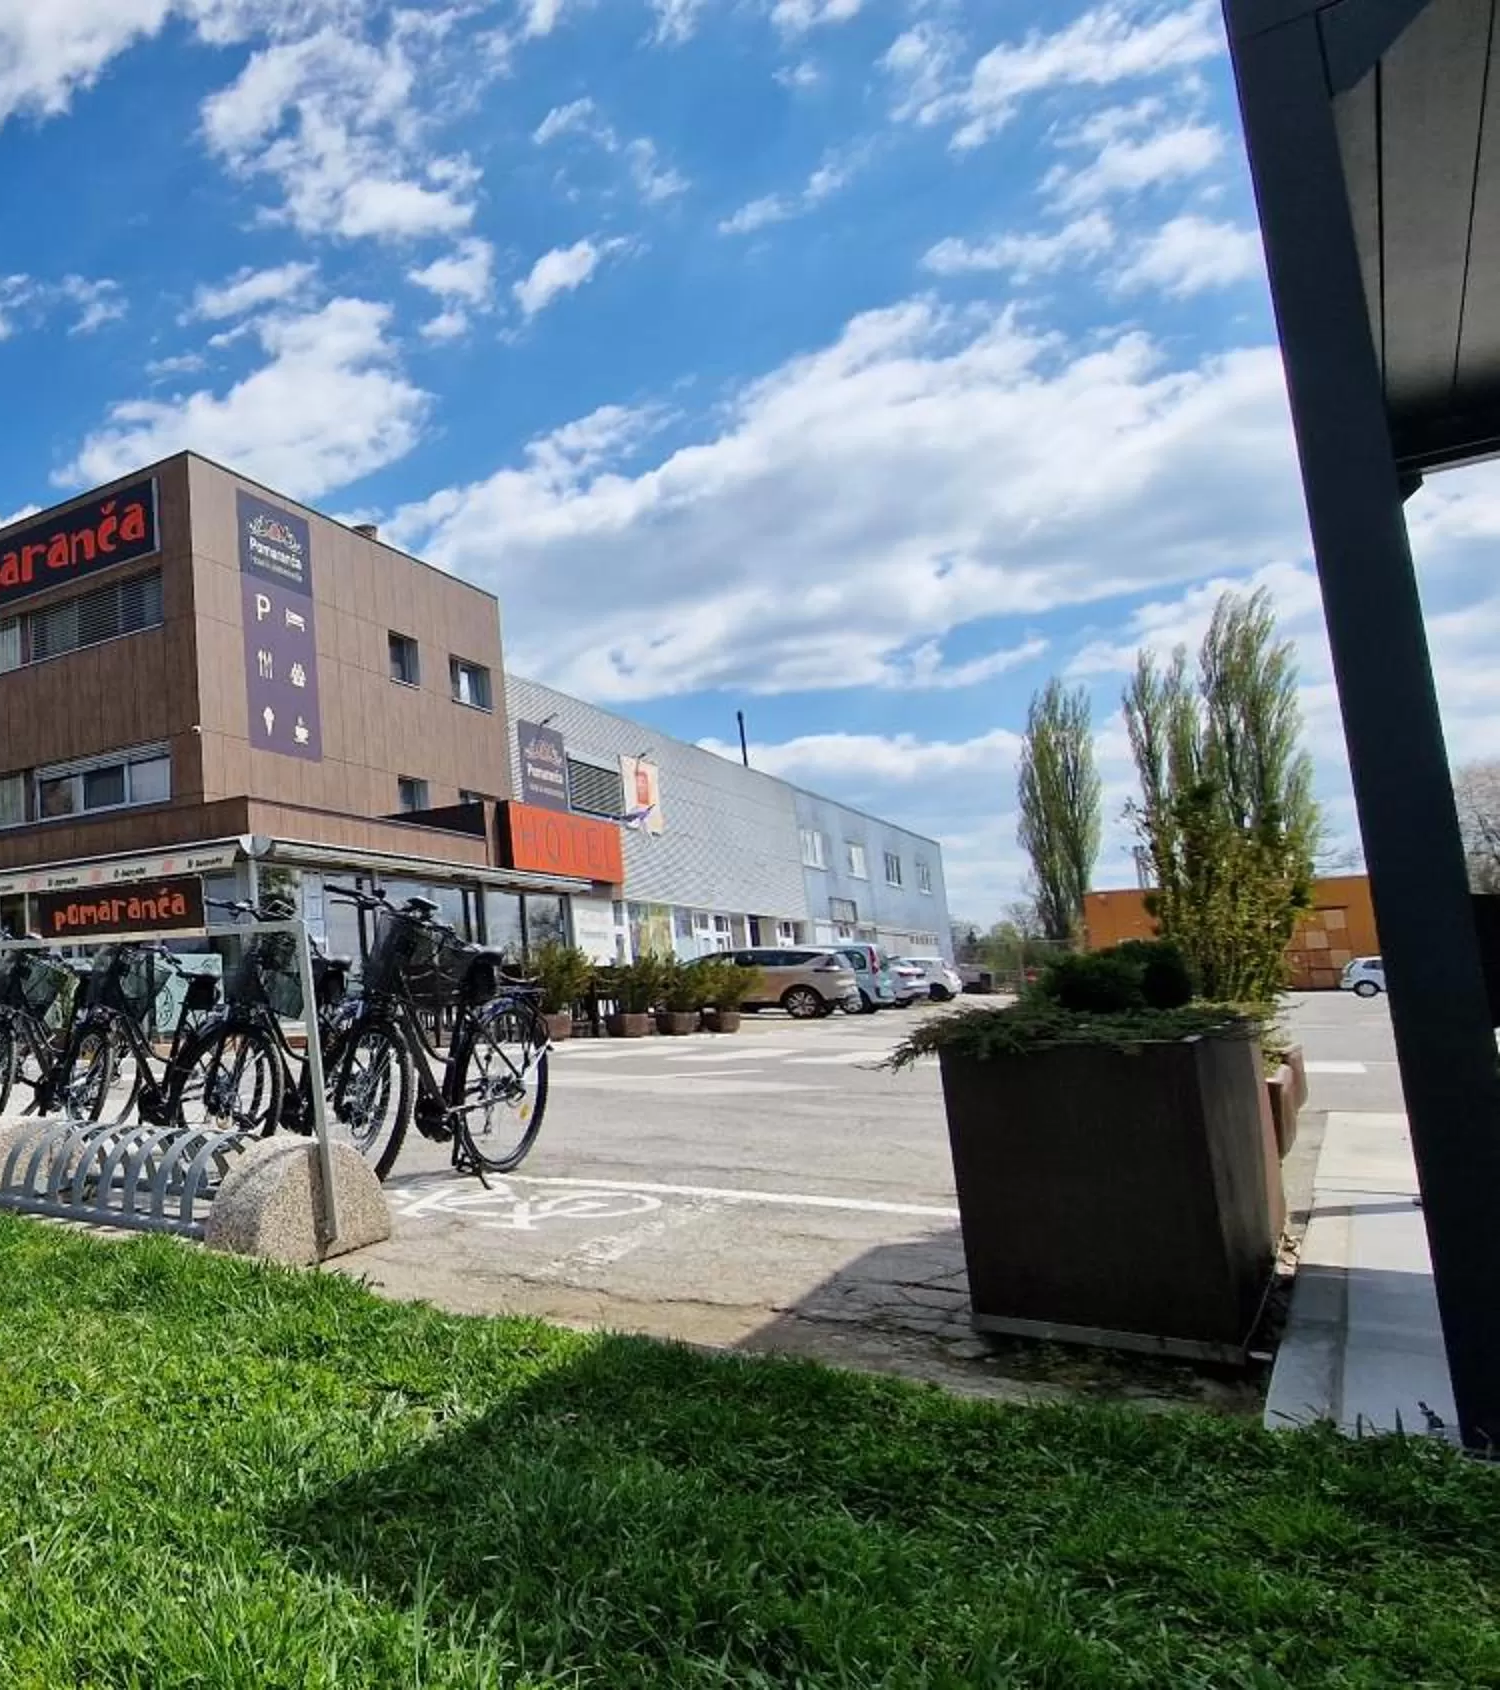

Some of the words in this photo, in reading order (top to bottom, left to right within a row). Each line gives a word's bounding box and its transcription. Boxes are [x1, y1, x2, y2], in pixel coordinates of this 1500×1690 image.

[255, 593, 271, 621] P
[519, 811, 618, 874] HOTEL
[54, 888, 186, 931] pomaranča
